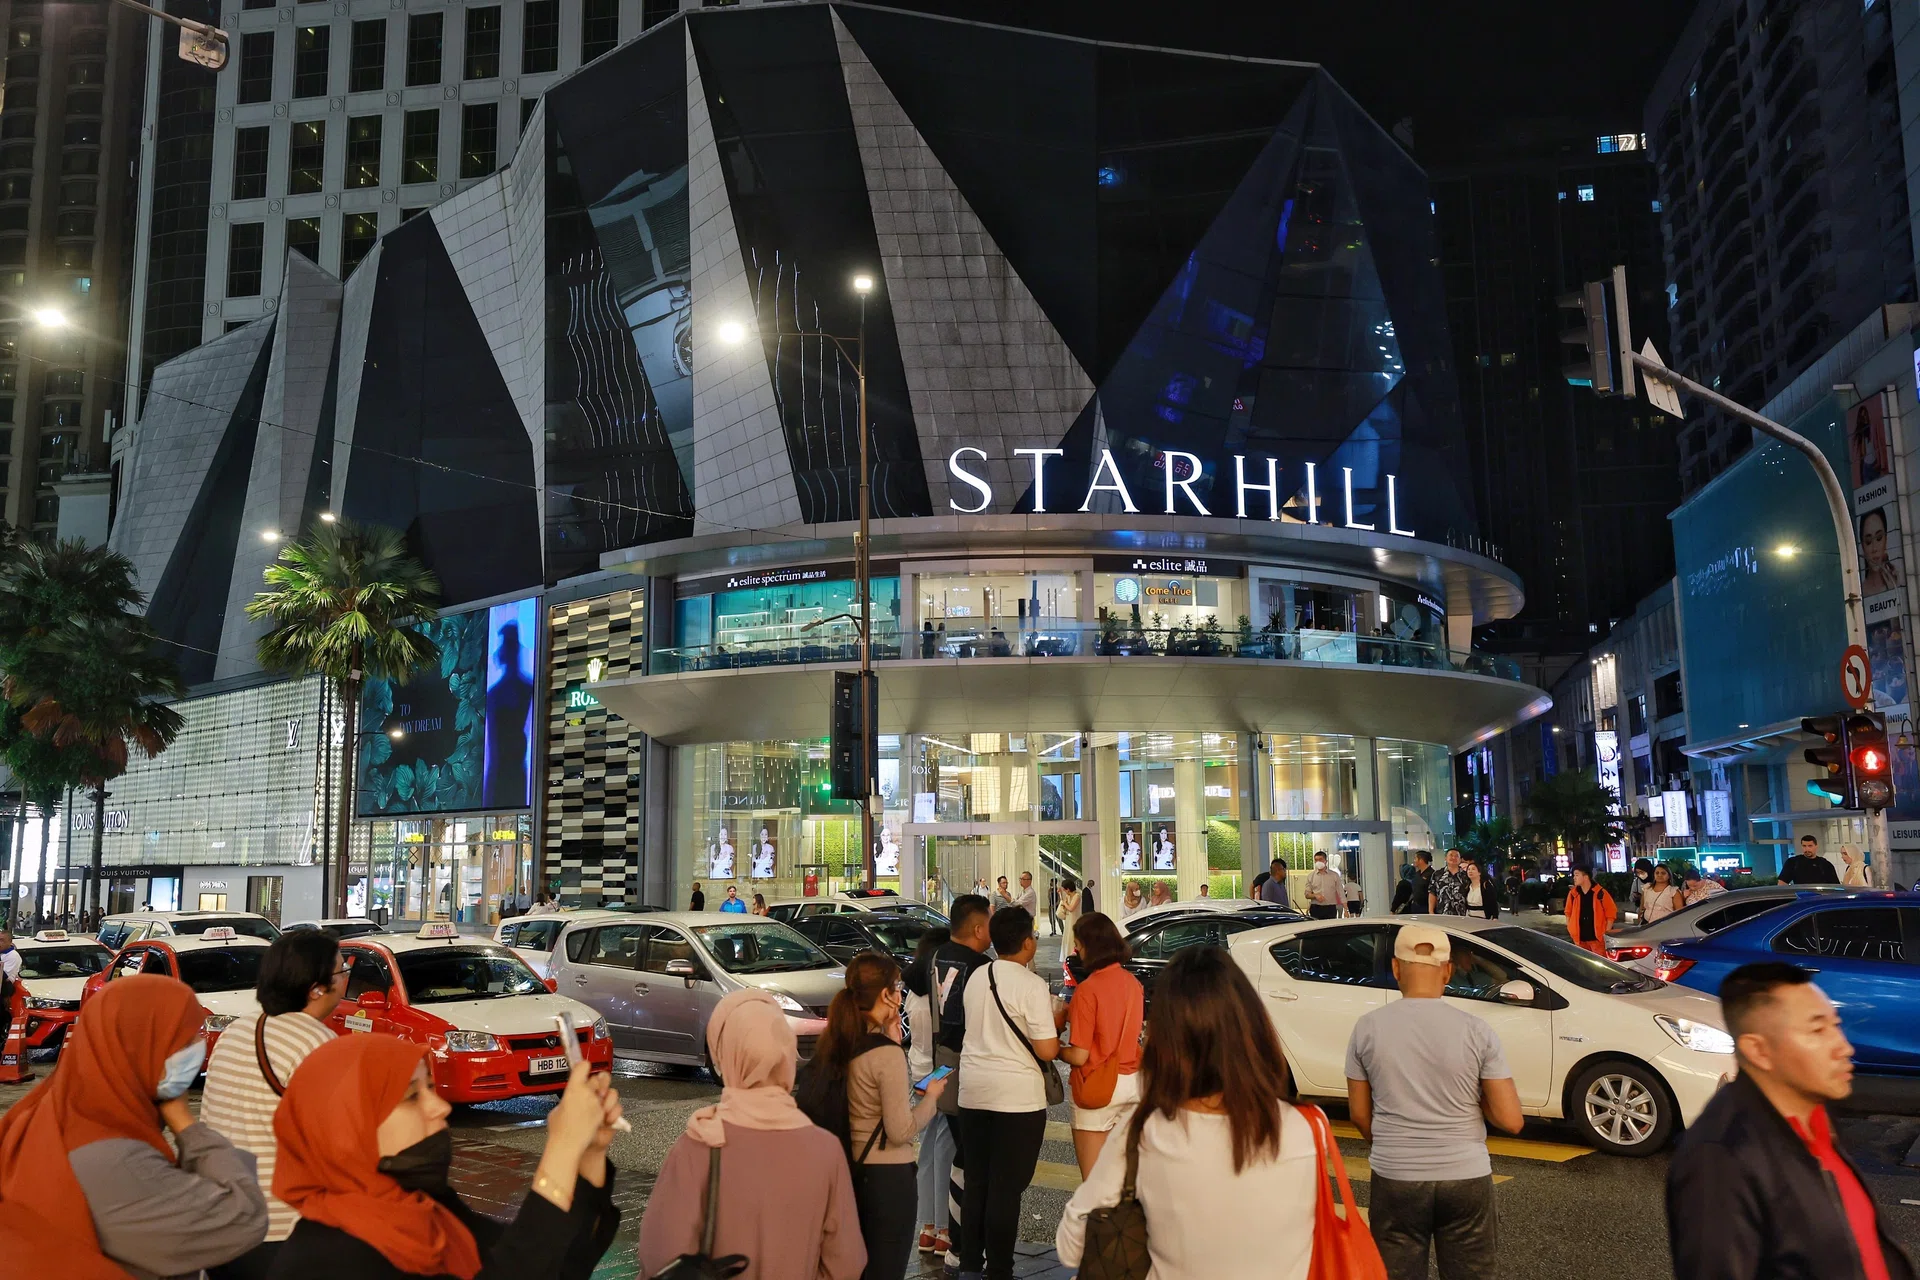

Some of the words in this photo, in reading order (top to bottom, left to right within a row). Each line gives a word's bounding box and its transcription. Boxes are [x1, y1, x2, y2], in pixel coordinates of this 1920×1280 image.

[948, 446, 1415, 537] STARHILL
[1858, 485, 1887, 505] FASHION
[1149, 558, 1182, 571] eslite
[739, 575, 760, 586] eslite
[761, 572, 801, 586] spectrum
[1145, 586, 1170, 596] Come
[1172, 586, 1192, 596] True
[1870, 598, 1897, 613] BEAUTY
[400, 704, 411, 717] TO
[102, 810, 130, 829] UITTON
[100, 869, 118, 877] OUIS
[537, 1060, 554, 1071] HBB
[556, 1058, 570, 1069] 112
